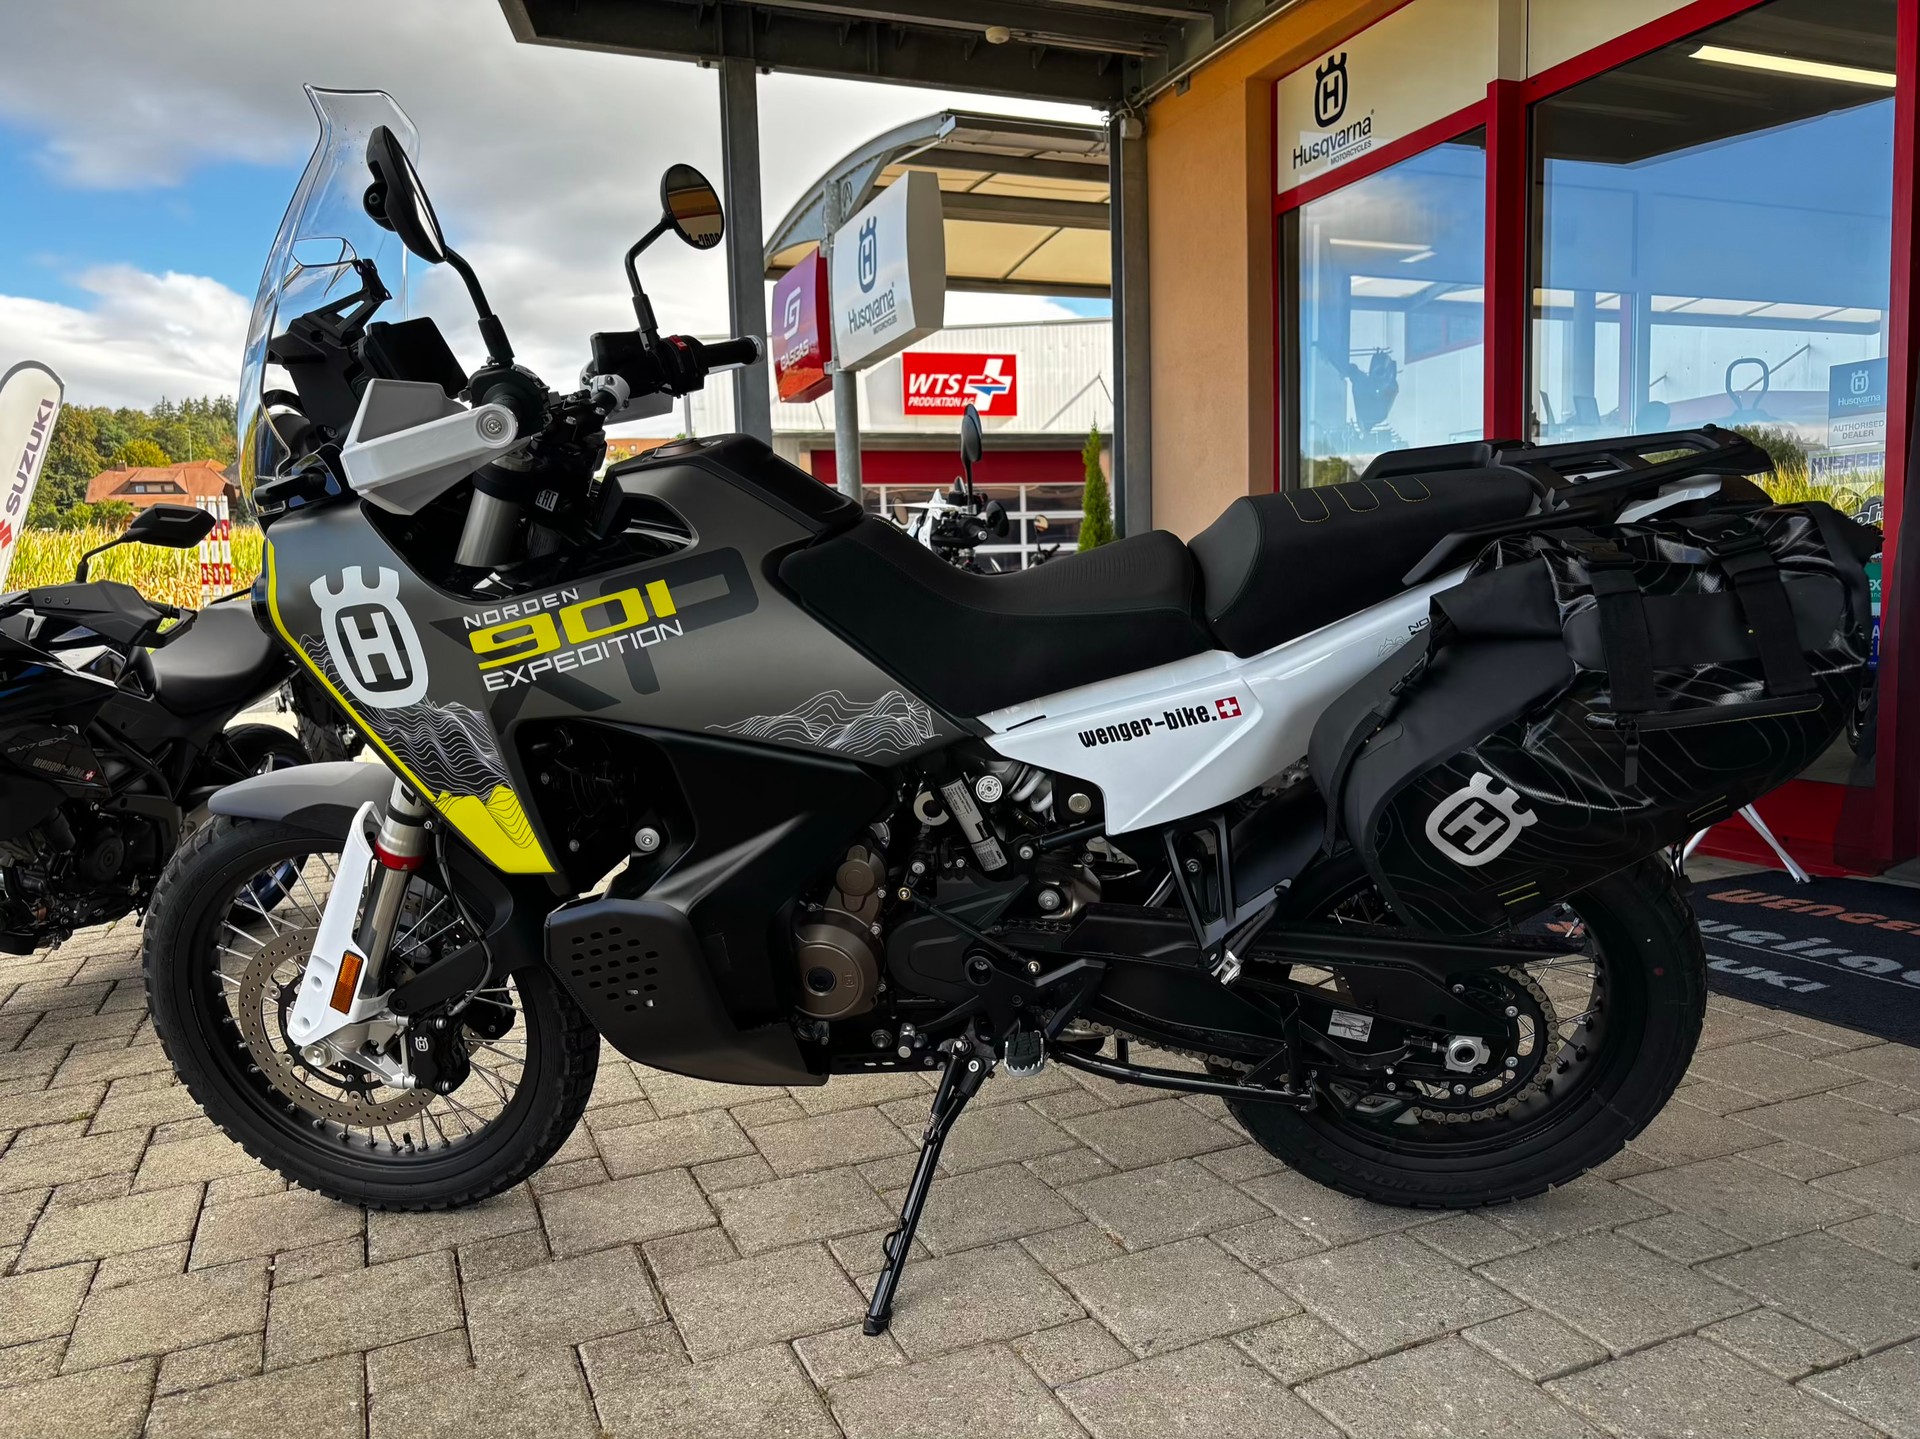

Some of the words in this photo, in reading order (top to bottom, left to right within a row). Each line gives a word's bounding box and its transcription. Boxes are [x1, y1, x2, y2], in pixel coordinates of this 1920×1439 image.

[1292, 116, 1372, 170] Husqvarna
[1330, 140, 1372, 166] MOTORCYCLES
[847, 288, 895, 335] Husqvarna
[780, 338, 809, 372] GASGAS
[908, 372, 963, 395] WTS
[1837, 393, 1881, 407] Husqvarna
[907, 396, 963, 408] PRODUKTION
[1832, 419, 1885, 433] AUTHORISED
[1842, 429, 1874, 440] DEALER
[5, 398, 55, 517] SUZUKI
[463, 587, 580, 630] NORDEN
[468, 578, 678, 671] 901
[482, 619, 684, 692] EXPEDITION
